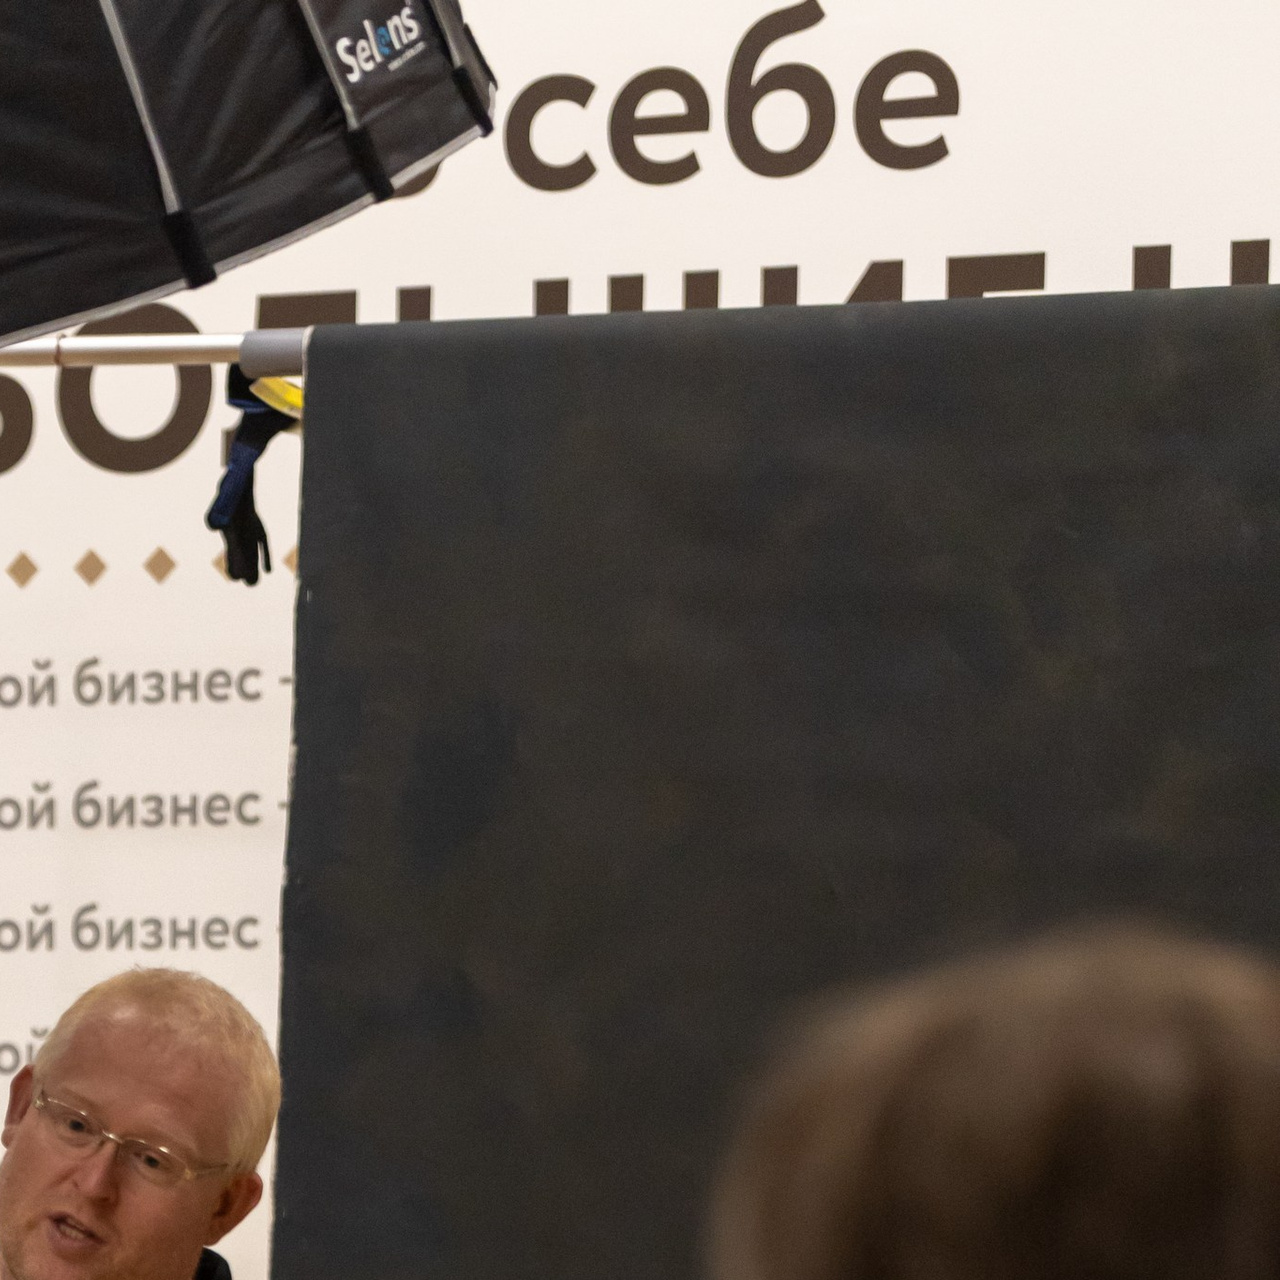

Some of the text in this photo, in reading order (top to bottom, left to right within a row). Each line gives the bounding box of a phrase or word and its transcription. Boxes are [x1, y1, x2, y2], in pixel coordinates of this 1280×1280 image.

[335, 6, 419, 83] Selens
[503, 0, 960, 192] себе
[72, 655, 262, 707] бизнес
[71, 778, 262, 830] бизнес
[70, 901, 260, 952] бизнес
